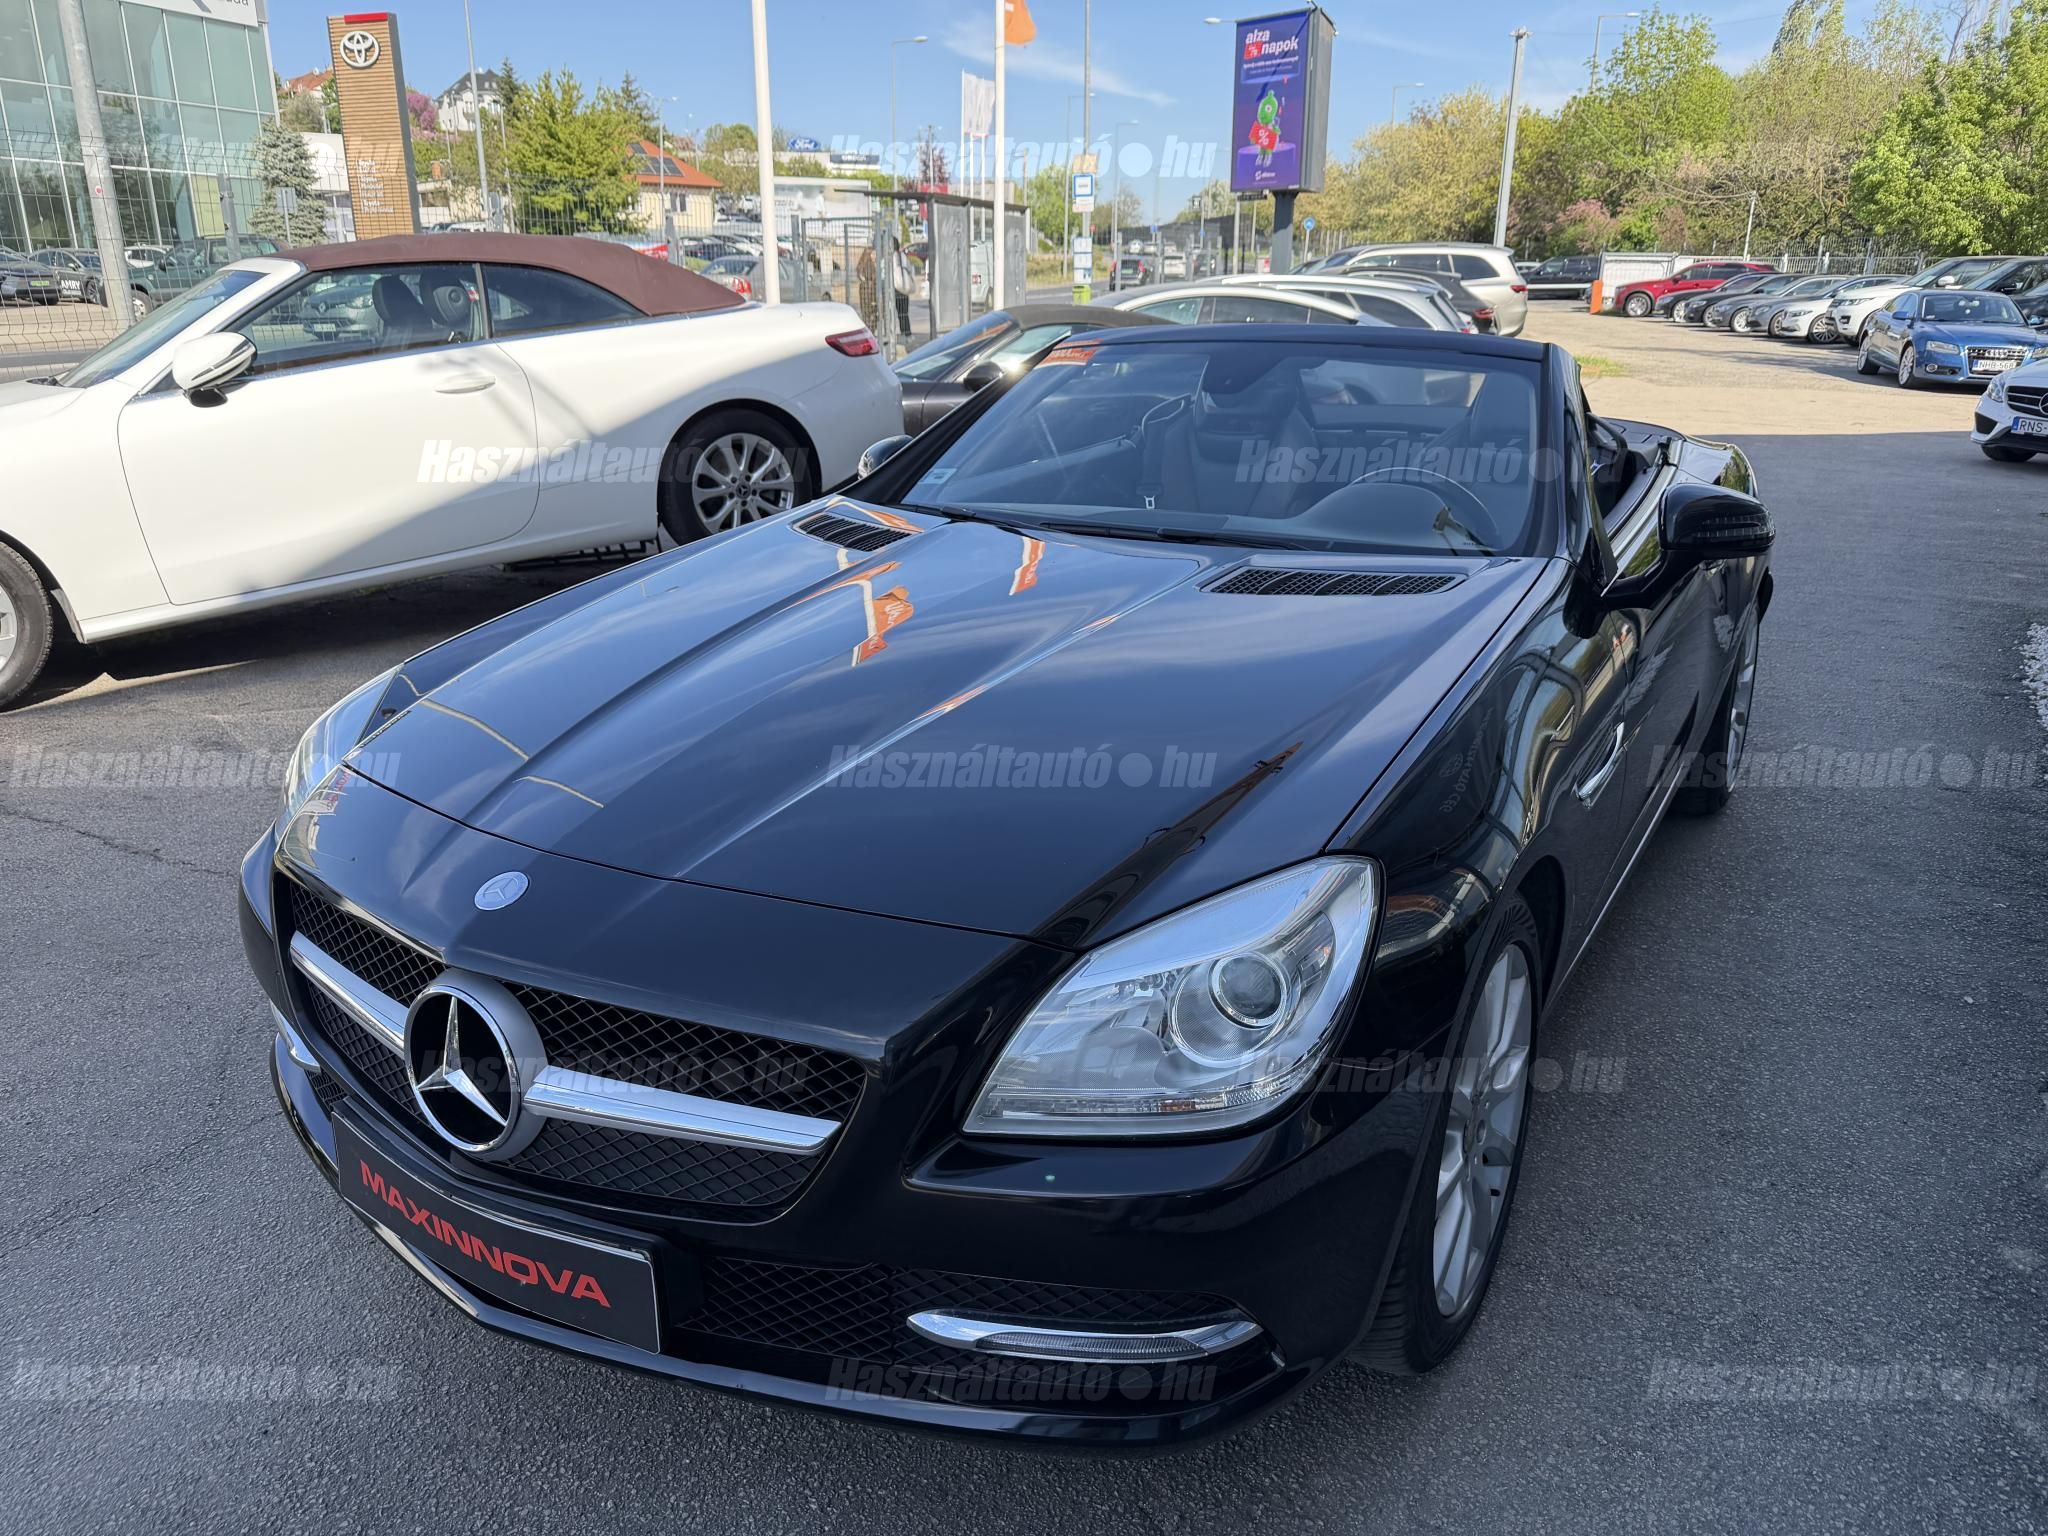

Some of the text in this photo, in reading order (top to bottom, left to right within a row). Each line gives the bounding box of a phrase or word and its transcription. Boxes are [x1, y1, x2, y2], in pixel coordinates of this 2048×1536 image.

[1245, 28, 1271, 44] alza
[1261, 36, 1299, 56] napok
[360, 1159, 612, 1309] MAXINNOVA
